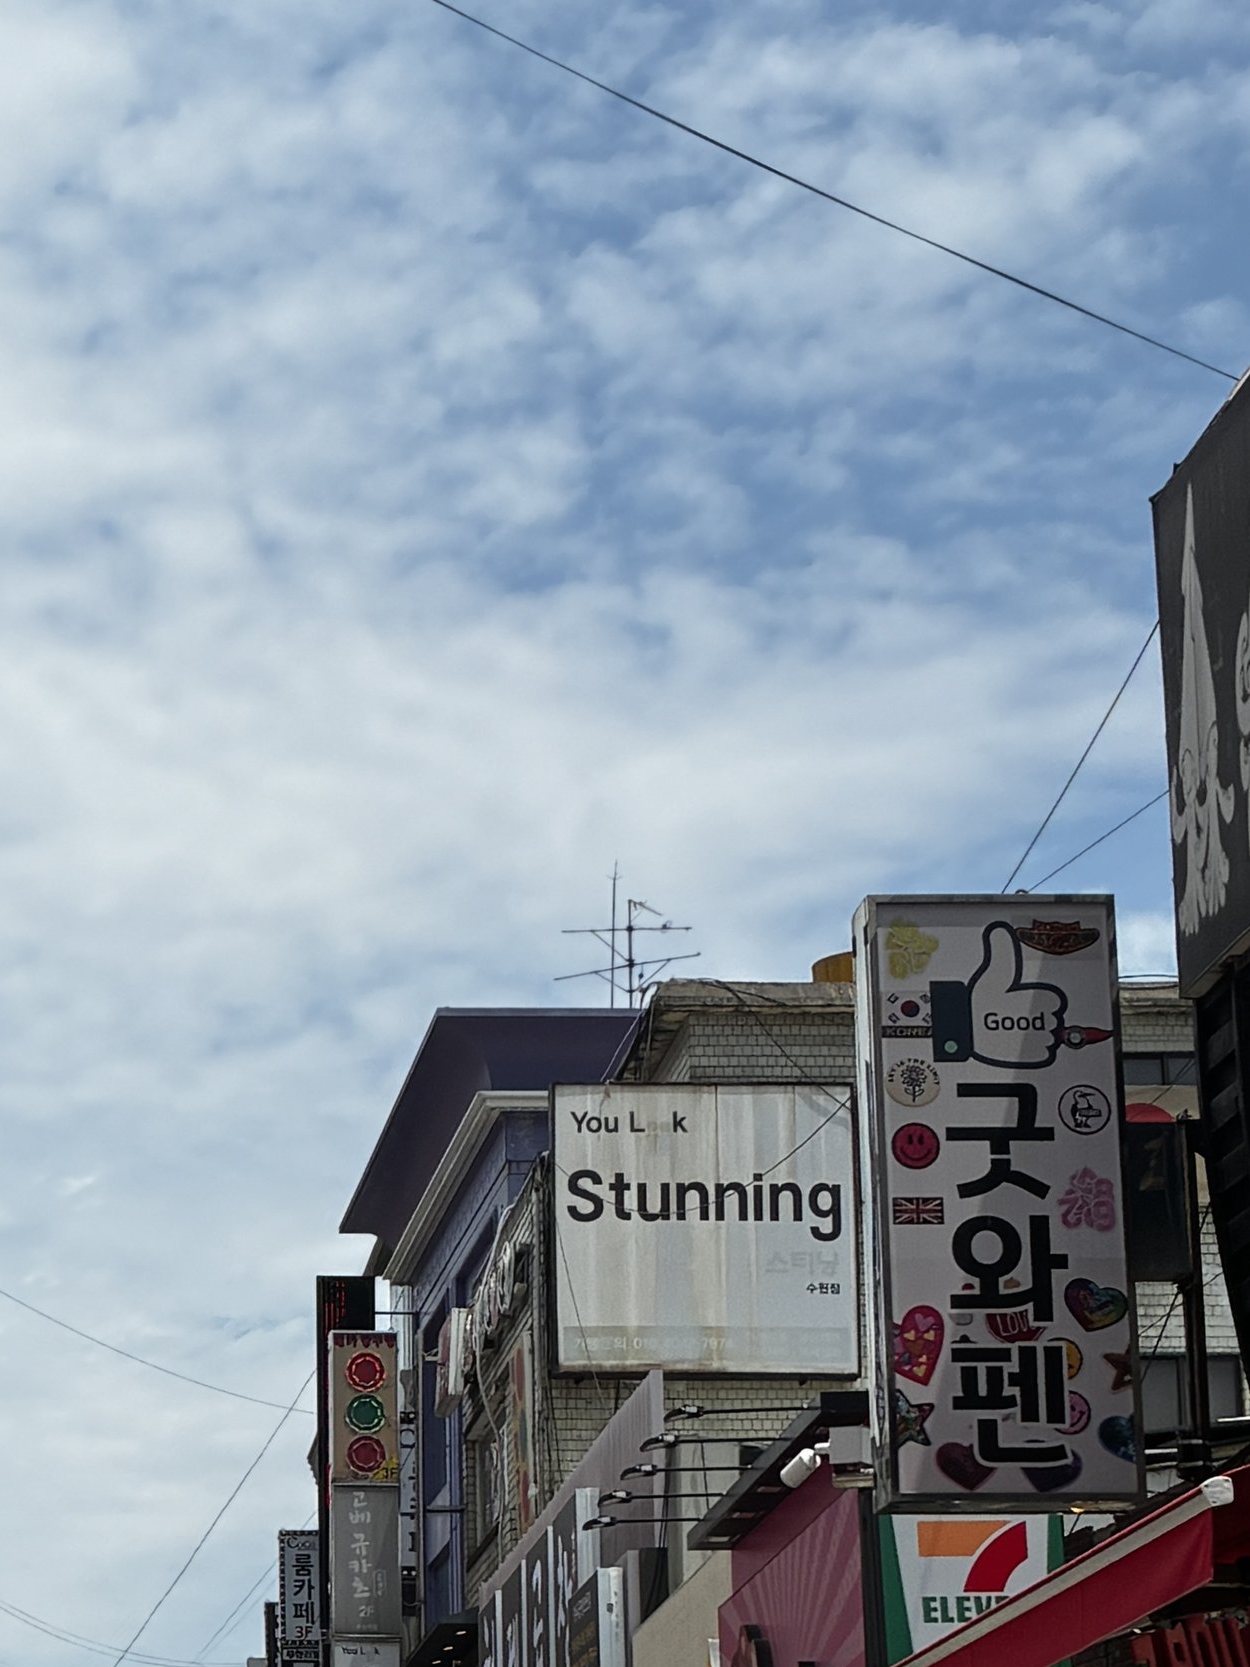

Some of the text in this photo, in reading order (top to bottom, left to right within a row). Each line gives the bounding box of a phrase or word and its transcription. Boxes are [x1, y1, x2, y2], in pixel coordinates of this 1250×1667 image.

[984, 1012, 1046, 1032] Good
[571, 1110, 688, 1134] You Lk
[566, 1169, 843, 1242] Stunning
[945, 1083, 1069, 1463] 굿와펜
[807, 1282, 841, 1295] 수원점
[292, 1553, 316, 1625] 룸카페
[923, 1596, 1012, 1624] ELEV
[294, 1625, 313, 1639] 3F
